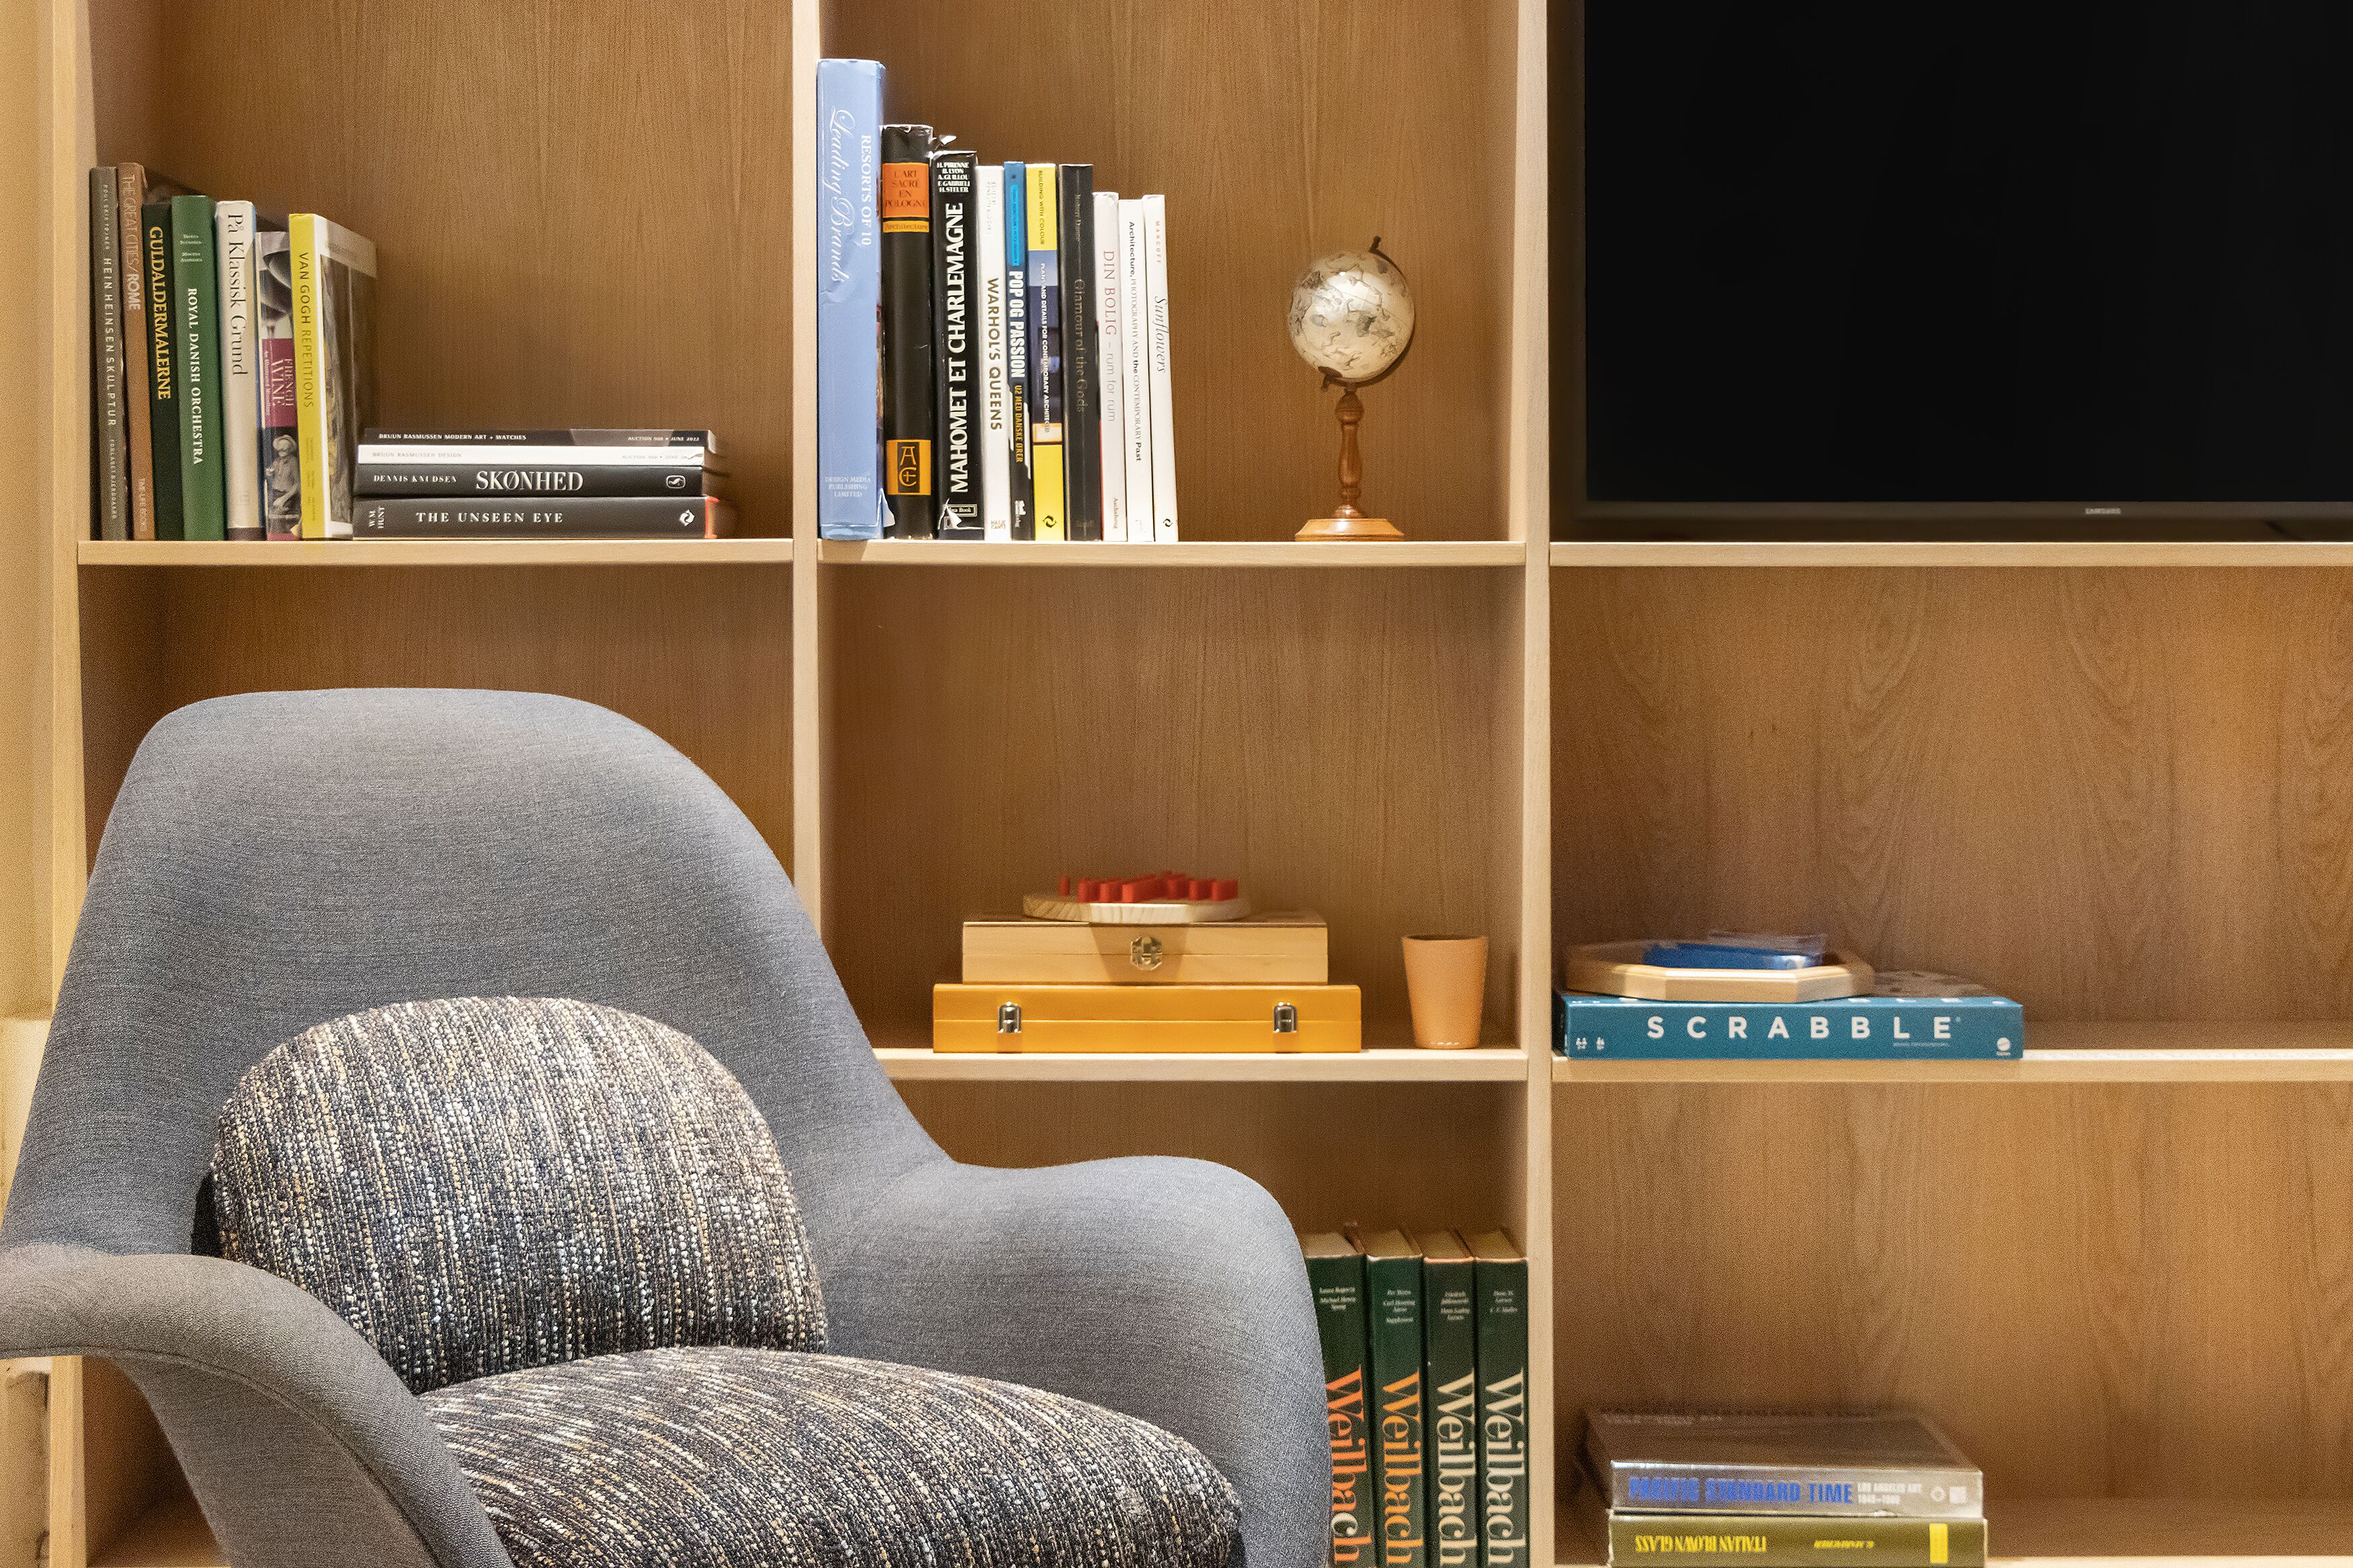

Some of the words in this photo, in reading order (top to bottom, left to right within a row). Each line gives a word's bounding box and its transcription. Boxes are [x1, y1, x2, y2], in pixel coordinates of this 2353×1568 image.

[822, 108, 856, 194] Leading
[861, 135, 872, 203] RESORTS
[122, 174, 136, 196] THE
[124, 197, 138, 232] GREAT
[228, 214, 245, 233] På
[861, 206, 872, 228] OF
[830, 196, 856, 282] Brands
[862, 232, 872, 246] 10
[1129, 222, 1138, 278] Architecture,
[103, 257, 113, 290] HEIN
[229, 241, 247, 308] Klassisk
[298, 252, 310, 281] VAN
[944, 203, 966, 354] CHARLEMAGNE
[1009, 271, 1024, 298] POP
[1103, 251, 1115, 280] DIN
[104, 294, 115, 353] HEINSEN
[149, 226, 171, 400] GULDALDERMALERNE
[188, 288, 198, 329] ROYAL
[300, 284, 311, 324] GOGH
[988, 278, 1001, 360] WARHOL'S
[1010, 299, 1024, 318] OG
[1075, 279, 1086, 337] Glamour
[1104, 288, 1117, 336] BOLIG
[1130, 279, 1140, 339] PHOTOGRAPHY
[230, 315, 249, 375] Grund
[1010, 321, 1025, 378] PASSION
[1075, 339, 1087, 353] of
[1152, 296, 1170, 374] Sunflowers
[188, 333, 200, 382] DANISH
[301, 329, 315, 408] REPETITIONS
[948, 357, 966, 382] ET
[1076, 357, 1087, 376] the
[1106, 353, 1115, 376] rum
[106, 357, 117, 426] SKULPTUR
[270, 358, 285, 407] WINE
[284, 358, 294, 408] FRENCH
[988, 366, 1002, 430] QUEENS
[1014, 385, 1022, 395] U2
[1076, 379, 1088, 413] Gods
[1107, 380, 1117, 395] for
[191, 387, 204, 465] ORCHESTRA
[1015, 413, 1023, 442] DANSKE
[1107, 400, 1116, 421] rum
[1133, 375, 1142, 440] CONTEMPORARY
[949, 387, 969, 493] MAHOMET
[1016, 443, 1024, 463] ØRER
[373, 474, 409, 483] DENNIS
[411, 475, 458, 483] KNUDSEN
[476, 470, 584, 491] SKØNHED
[377, 505, 385, 529] HUNT
[415, 512, 450, 523] THE
[457, 512, 524, 524] UNSEEN
[533, 512, 563, 523] EYE
[1647, 1016, 1952, 1039] SCRABBLE
[1326, 1364, 1372, 1564] Weilbach
[1382, 1366, 1425, 1565] Weilbach
[1436, 1367, 1478, 1567] Weilbach
[1484, 1366, 1527, 1566] Weilbach
[1630, 1477, 1700, 1500] PACIFIC
[1704, 1478, 1801, 1503] STANDARD
[1808, 1482, 1853, 1504] TIME
[1634, 1535, 1674, 1553] GLASS
[1675, 1536, 1718, 1553] BLOWN
[1719, 1536, 1767, 1553] ITALIAN
